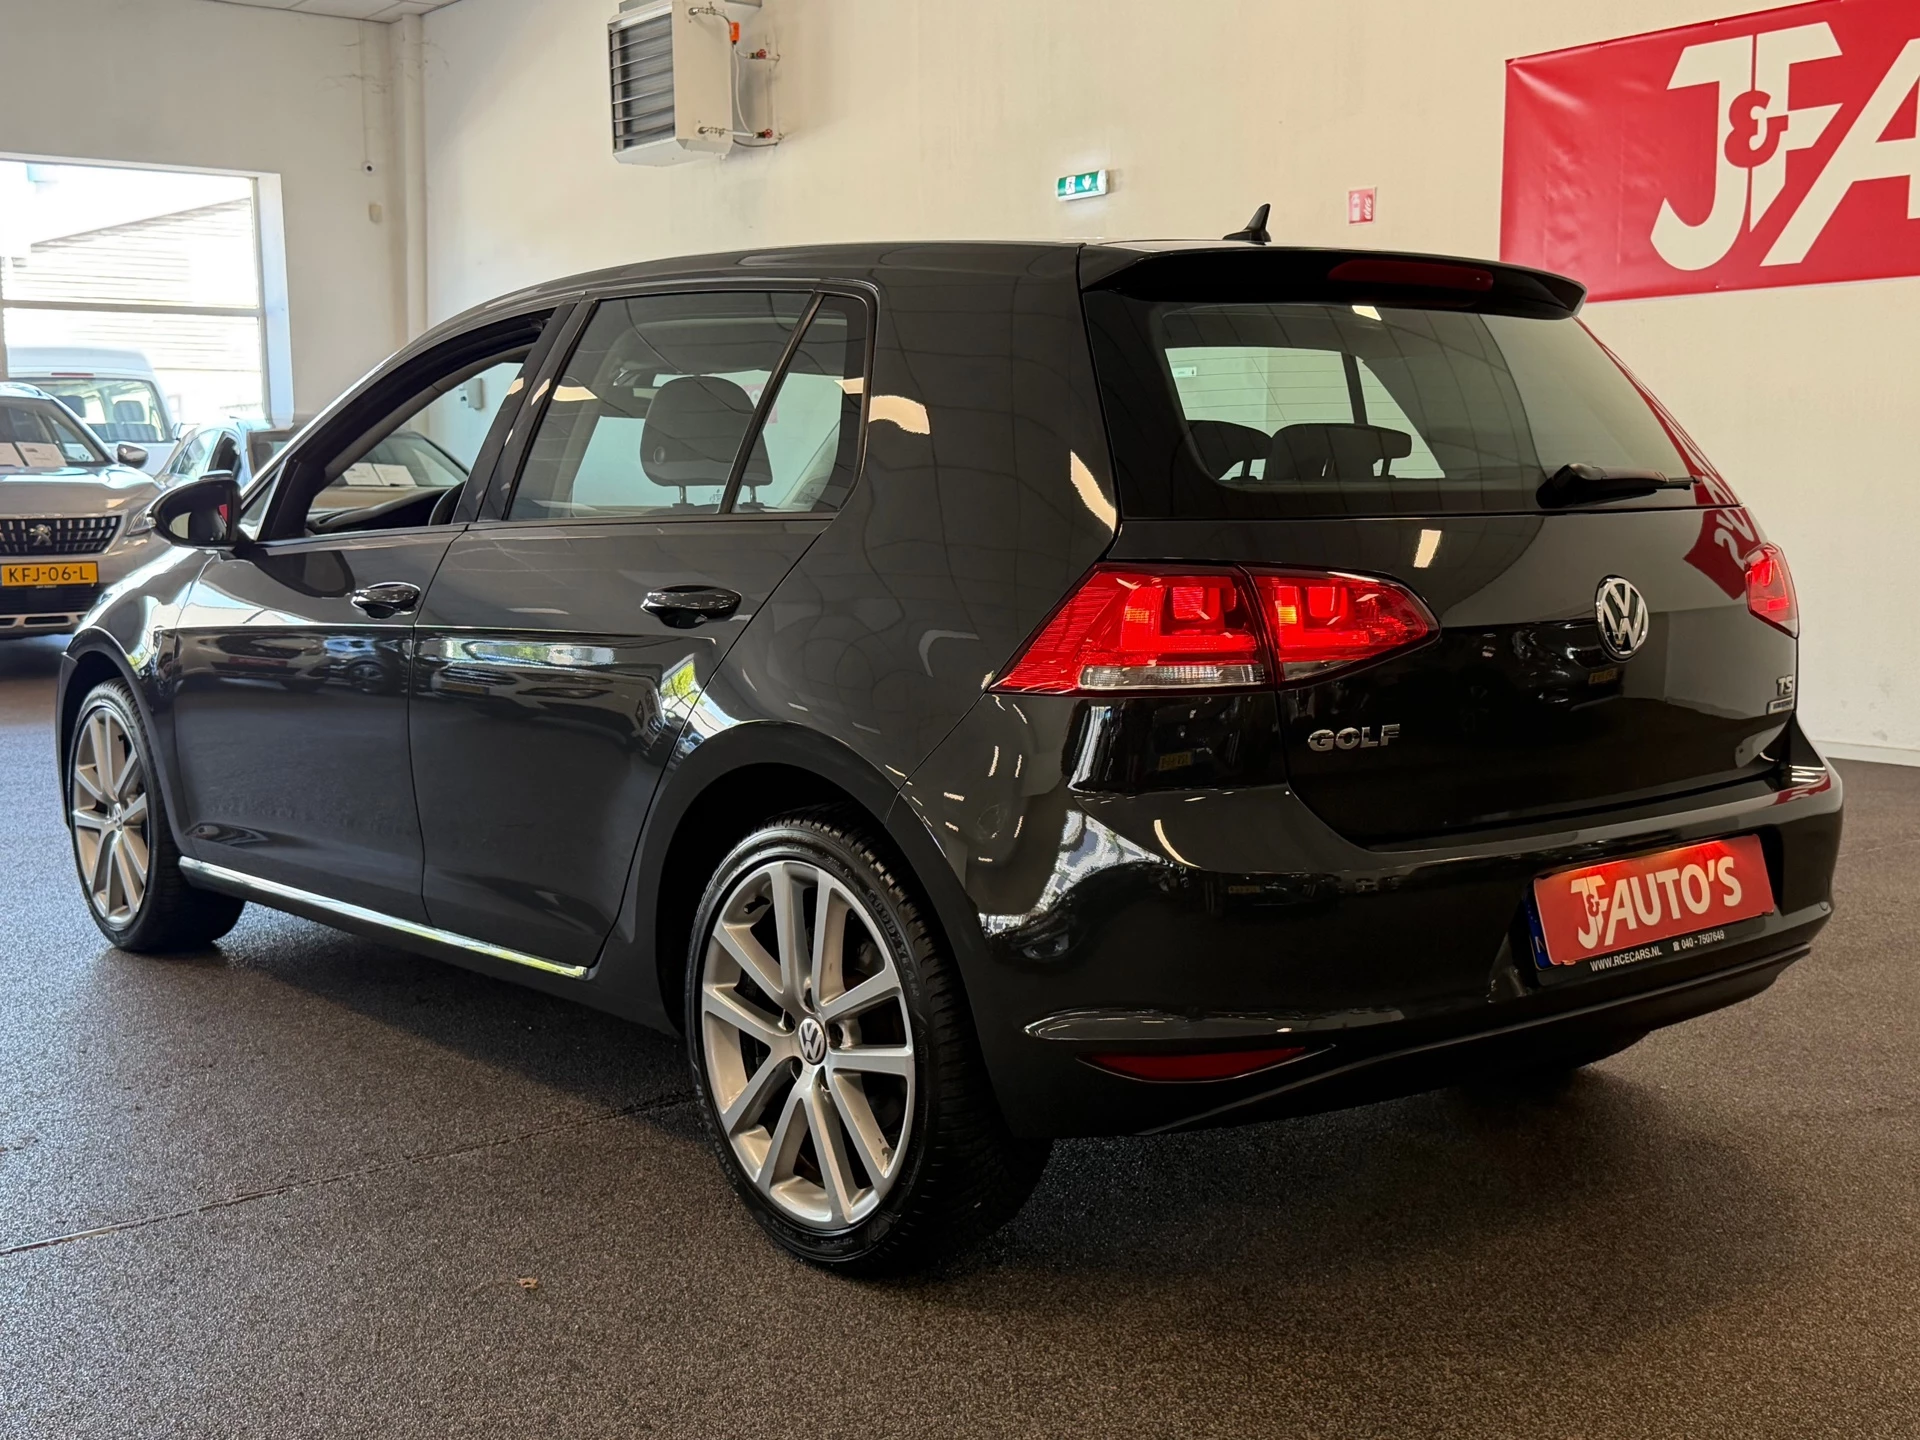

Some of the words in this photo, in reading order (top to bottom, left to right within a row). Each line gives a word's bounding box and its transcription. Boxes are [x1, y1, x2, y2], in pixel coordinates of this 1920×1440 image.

[8, 565, 89, 583] KFJ-06-L
[1308, 723, 1400, 752] GOLF
[1604, 855, 1742, 946] AUTO'S
[1590, 945, 1662, 972] WWW.RCECARS.NL
[1681, 937, 1694, 949] 040
[1698, 930, 1725, 945] 7507649
